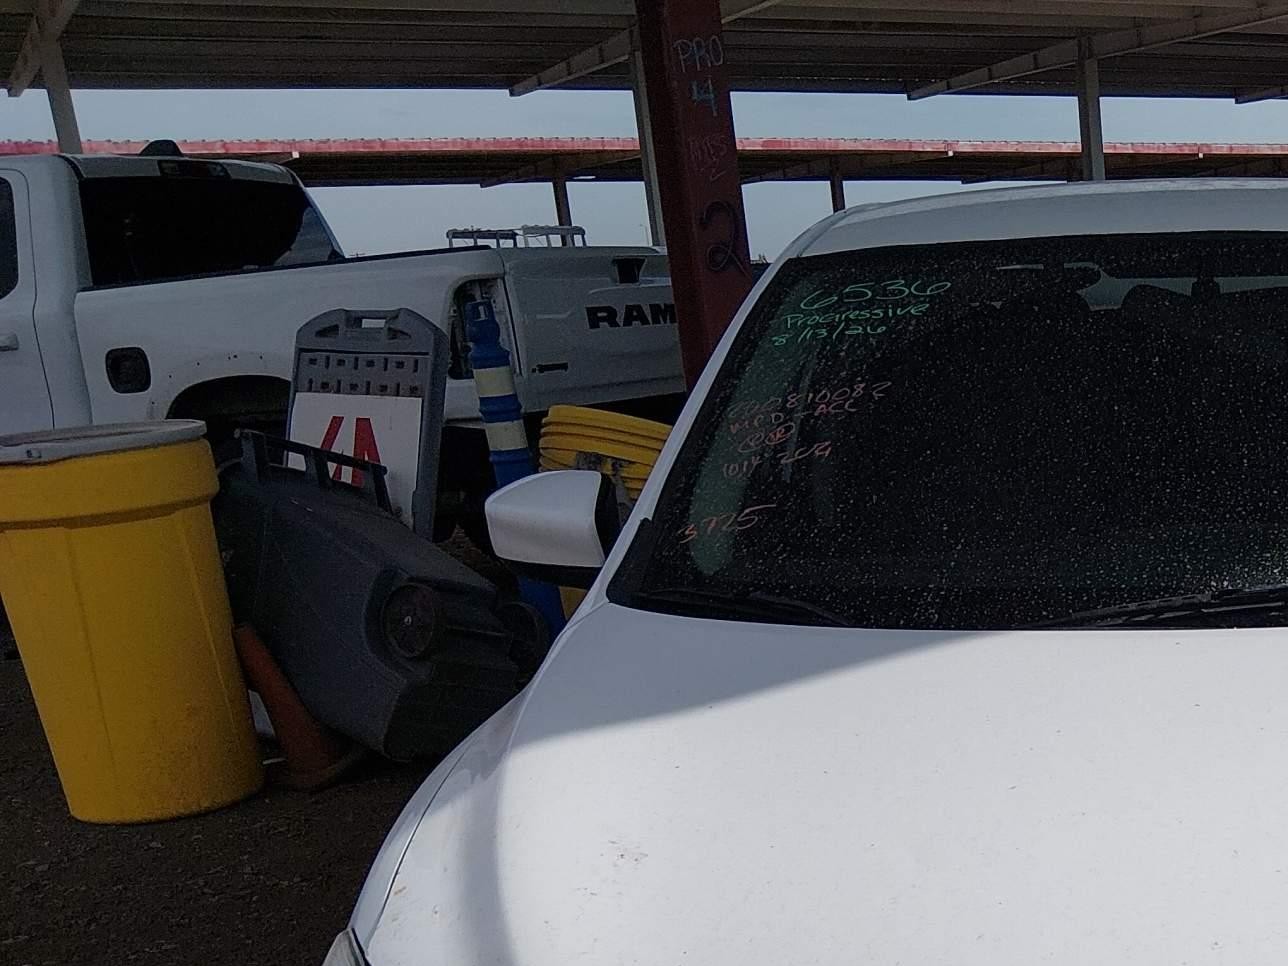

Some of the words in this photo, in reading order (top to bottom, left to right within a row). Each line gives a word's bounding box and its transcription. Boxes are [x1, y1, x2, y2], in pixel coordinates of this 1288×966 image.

[672, 35, 723, 73] PRO
[800, 280, 952, 310] 6536
[585, 303, 678, 330] RAM
